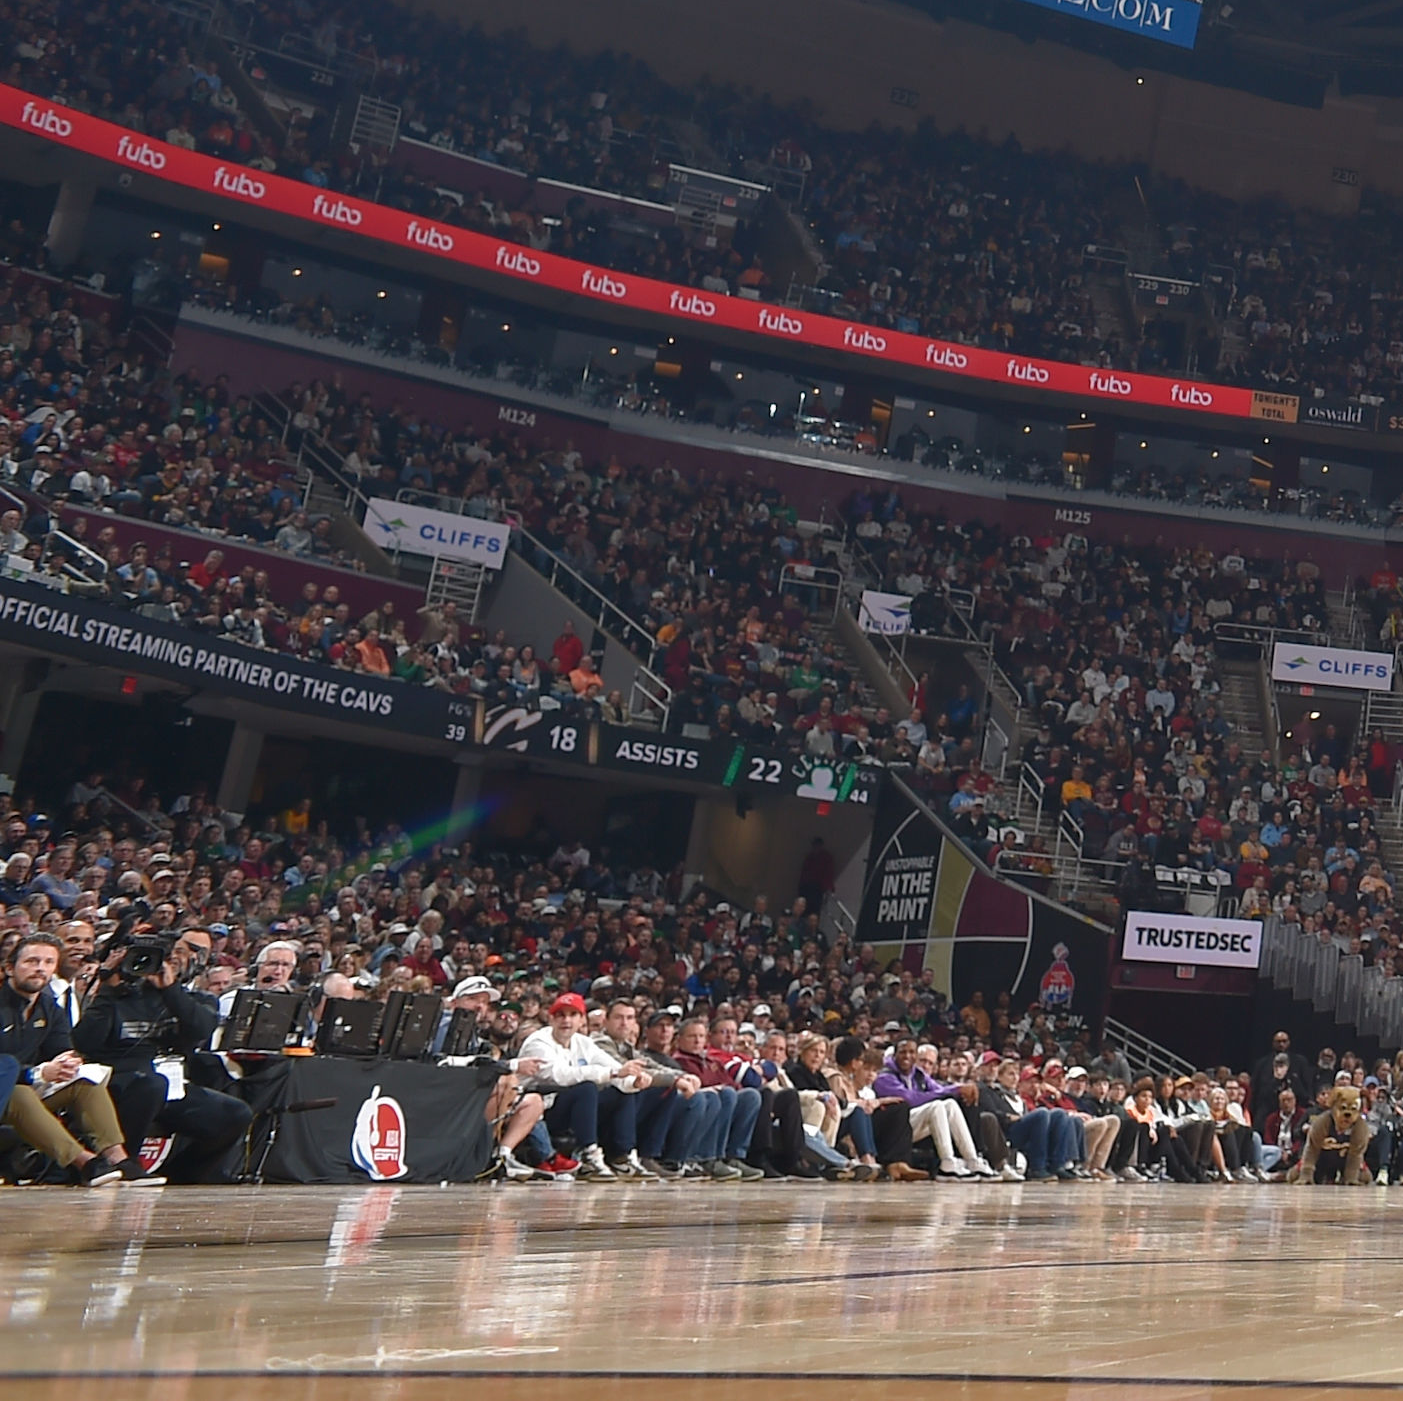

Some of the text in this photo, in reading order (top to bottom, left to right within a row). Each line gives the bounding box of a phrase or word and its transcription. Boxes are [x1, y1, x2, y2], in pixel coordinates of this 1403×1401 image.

[738, 186, 760, 200] 229
[21, 102, 1212, 407] fubo fubo fubo fubo fubo fubo fubo fubo fubo fubo fubo fubo fubo fubo
[1138, 279, 1190, 296] 229 230
[498, 406, 536, 429] M124
[1261, 407, 1285, 420] TOTAL
[1308, 405, 1363, 424] oswald
[1054, 508, 1092, 525] M125
[418, 523, 502, 554] CLIFFS
[81, 618, 193, 668] STREAMING
[194, 648, 272, 689] PARTNER
[274, 670, 302, 694] OF
[301, 677, 338, 704] THE
[340, 686, 393, 715] CAVS
[1318, 659, 1388, 678] CLIFFS
[445, 723, 466, 741] 39
[548, 725, 577, 752] 18
[616, 740, 699, 769] ASSISTS
[748, 757, 783, 783] 22
[849, 788, 869, 804] 44
[885, 855, 935, 872] UNSTOPPABLE
[881, 873, 932, 896] IN THE
[876, 897, 929, 923] PAINT
[1135, 927, 1253, 953] TRUSTEDSEC
